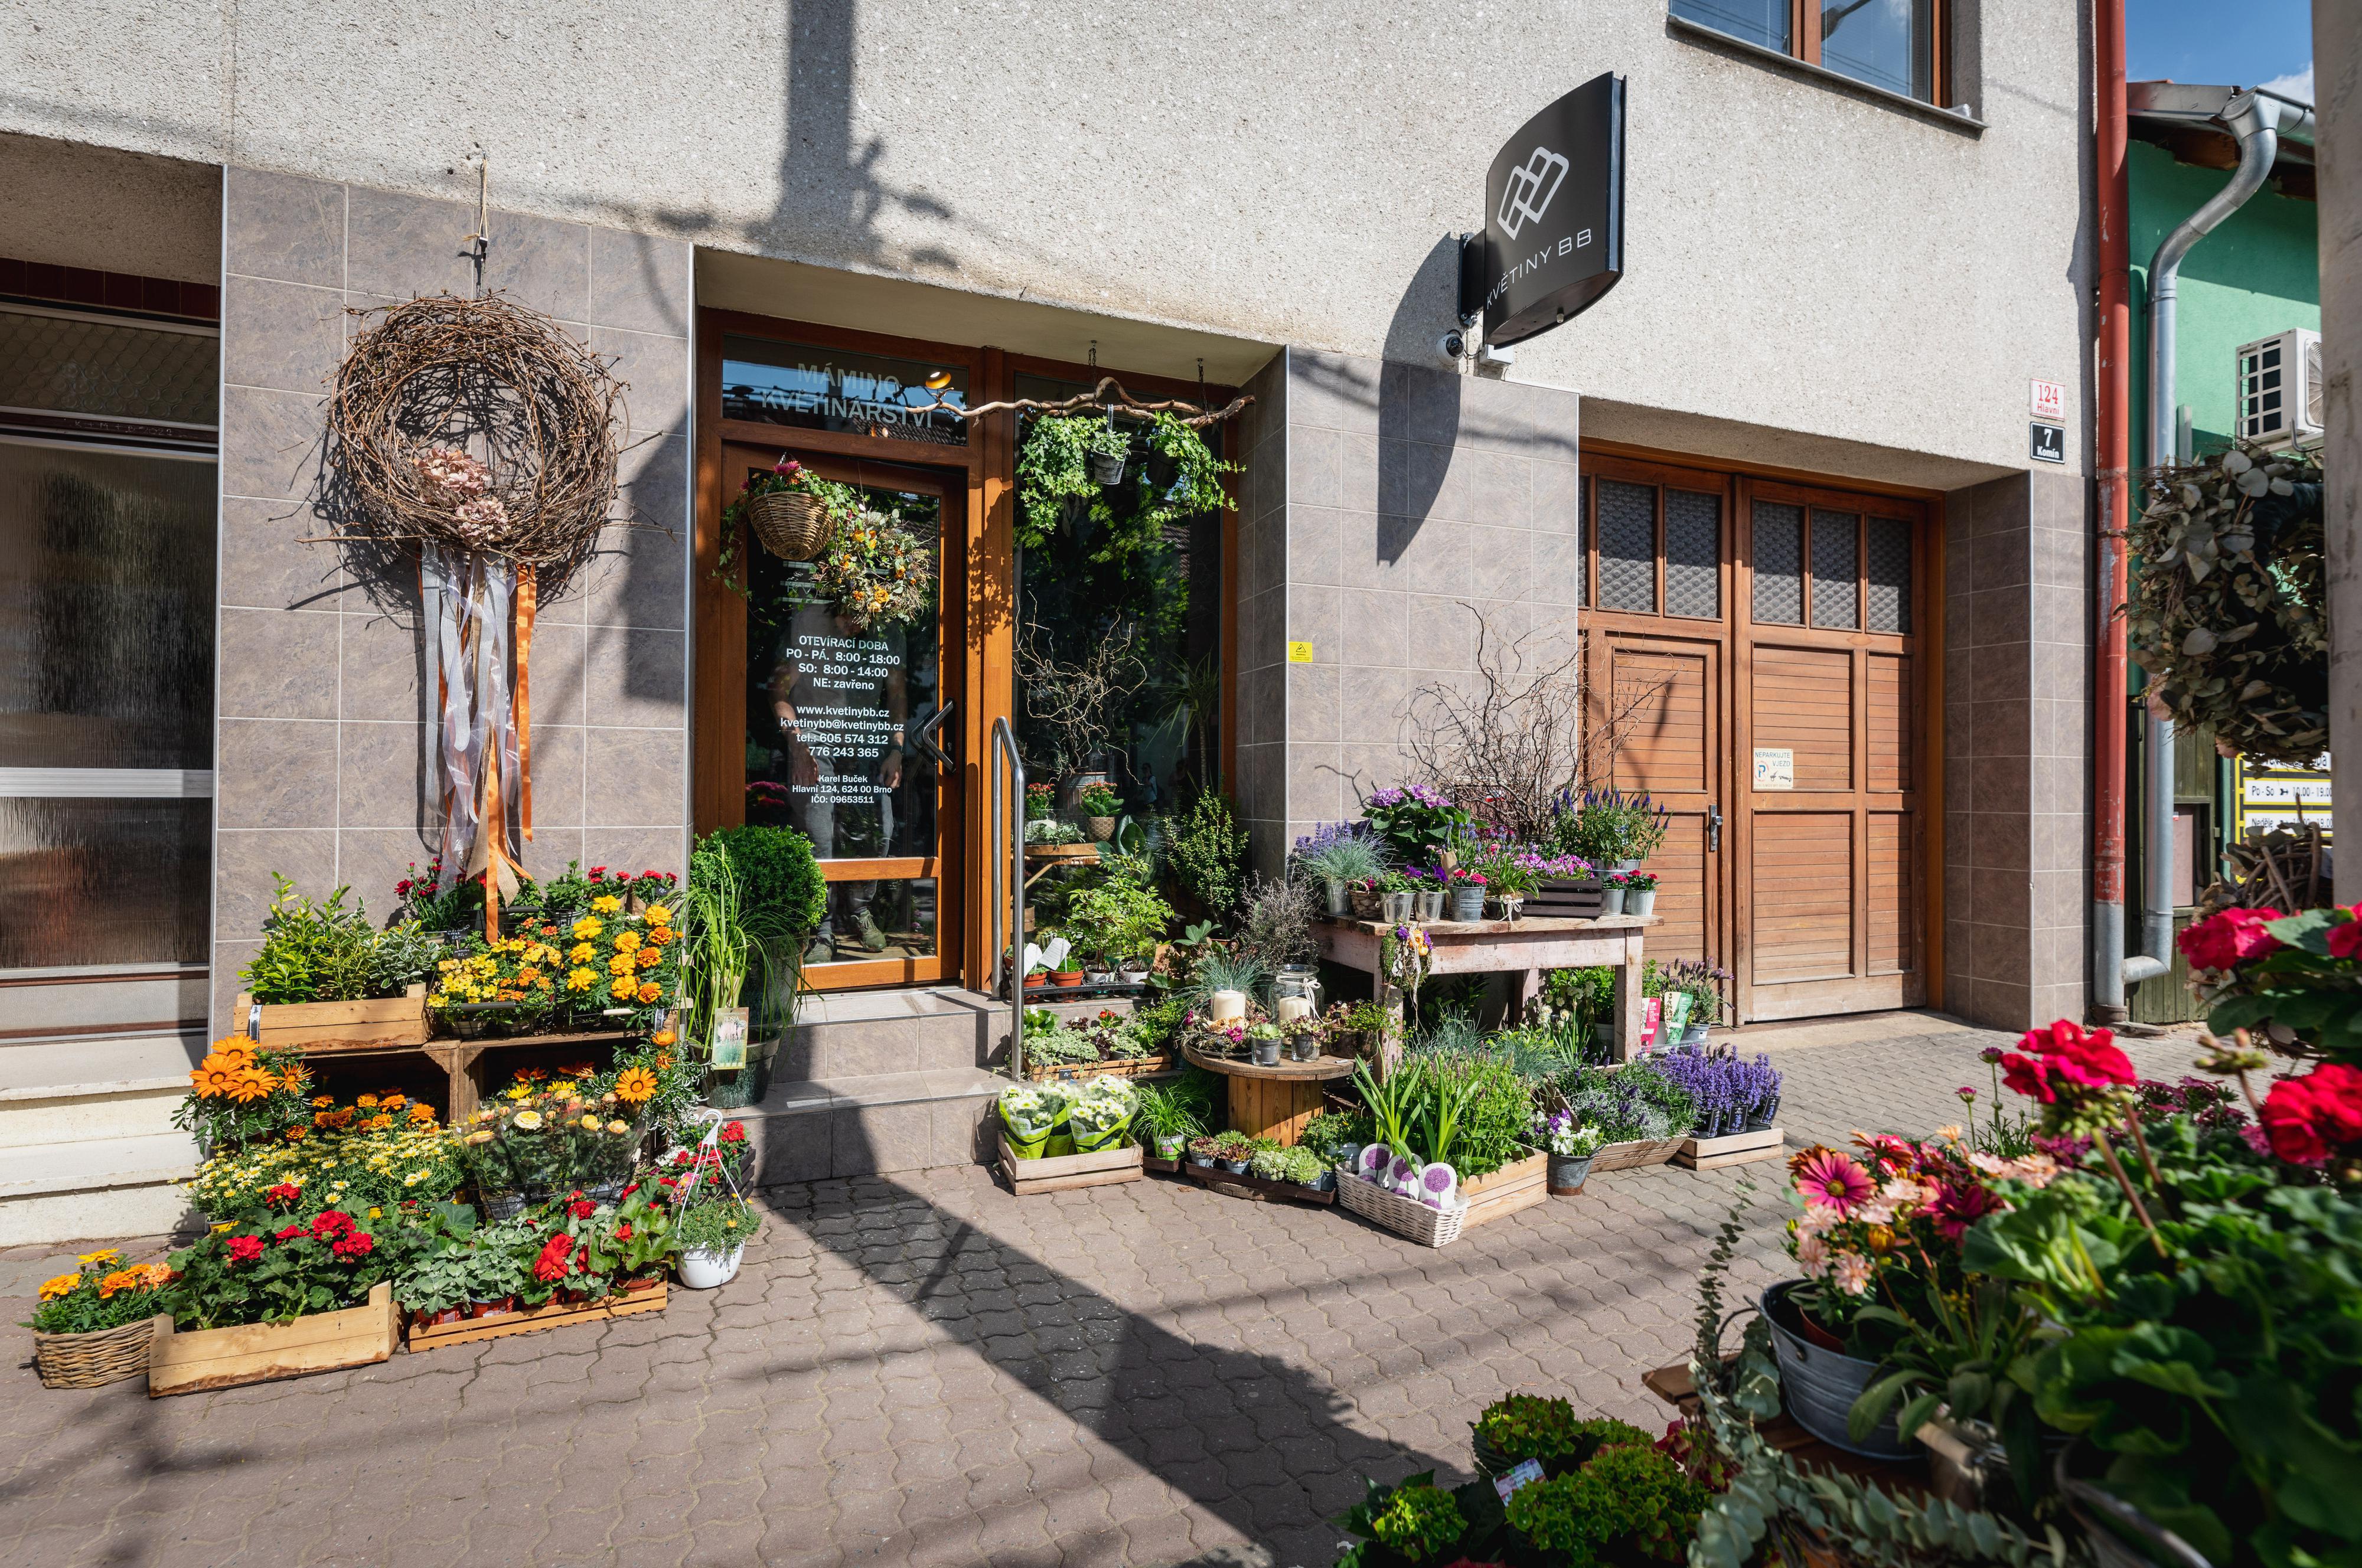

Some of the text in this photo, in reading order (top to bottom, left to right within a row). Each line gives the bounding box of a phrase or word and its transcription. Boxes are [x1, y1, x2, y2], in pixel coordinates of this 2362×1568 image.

[1486, 227, 1593, 311] KVĚTINY BB
[797, 361, 901, 395] MÁMINO
[2038, 384, 2058, 404] 124
[761, 388, 932, 429] KVĚTINÁŘSTVÍ
[2037, 402, 2060, 415] Hlavní
[2044, 428, 2053, 447] 7
[2037, 445, 2060, 459] Komín
[799, 635, 889, 651] OTEVÍRACÍ DOBA
[786, 648, 802, 659] PO
[811, 648, 830, 661] PÁ.
[835, 651, 860, 662] 8:00
[869, 654, 901, 665] 18:00
[798, 662, 817, 673] SO:
[823, 665, 849, 675] 8:00
[857, 666, 888, 678] 14:00
[813, 677, 875, 690] NE: zavřeno
[796, 705, 889, 718] www.kvetinybb.cz
[780, 717, 904, 732] kvetinybb@kvetinybb.cz
[819, 733, 841, 743] 605
[844, 734, 865, 744] 574
[867, 734, 889, 744] 312
[808, 746, 879, 757] 776 243 365
[818, 775, 868, 783] Karel Buček
[792, 785, 818, 793] Hlavní
[820, 785, 840, 795] 124,
[841, 785, 859, 793] 624
[873, 786, 892, 794] Brno
[2252, 786, 2260, 796] Po
[2266, 786, 2275, 796] So
[811, 794, 874, 803] IČO: 09653511
